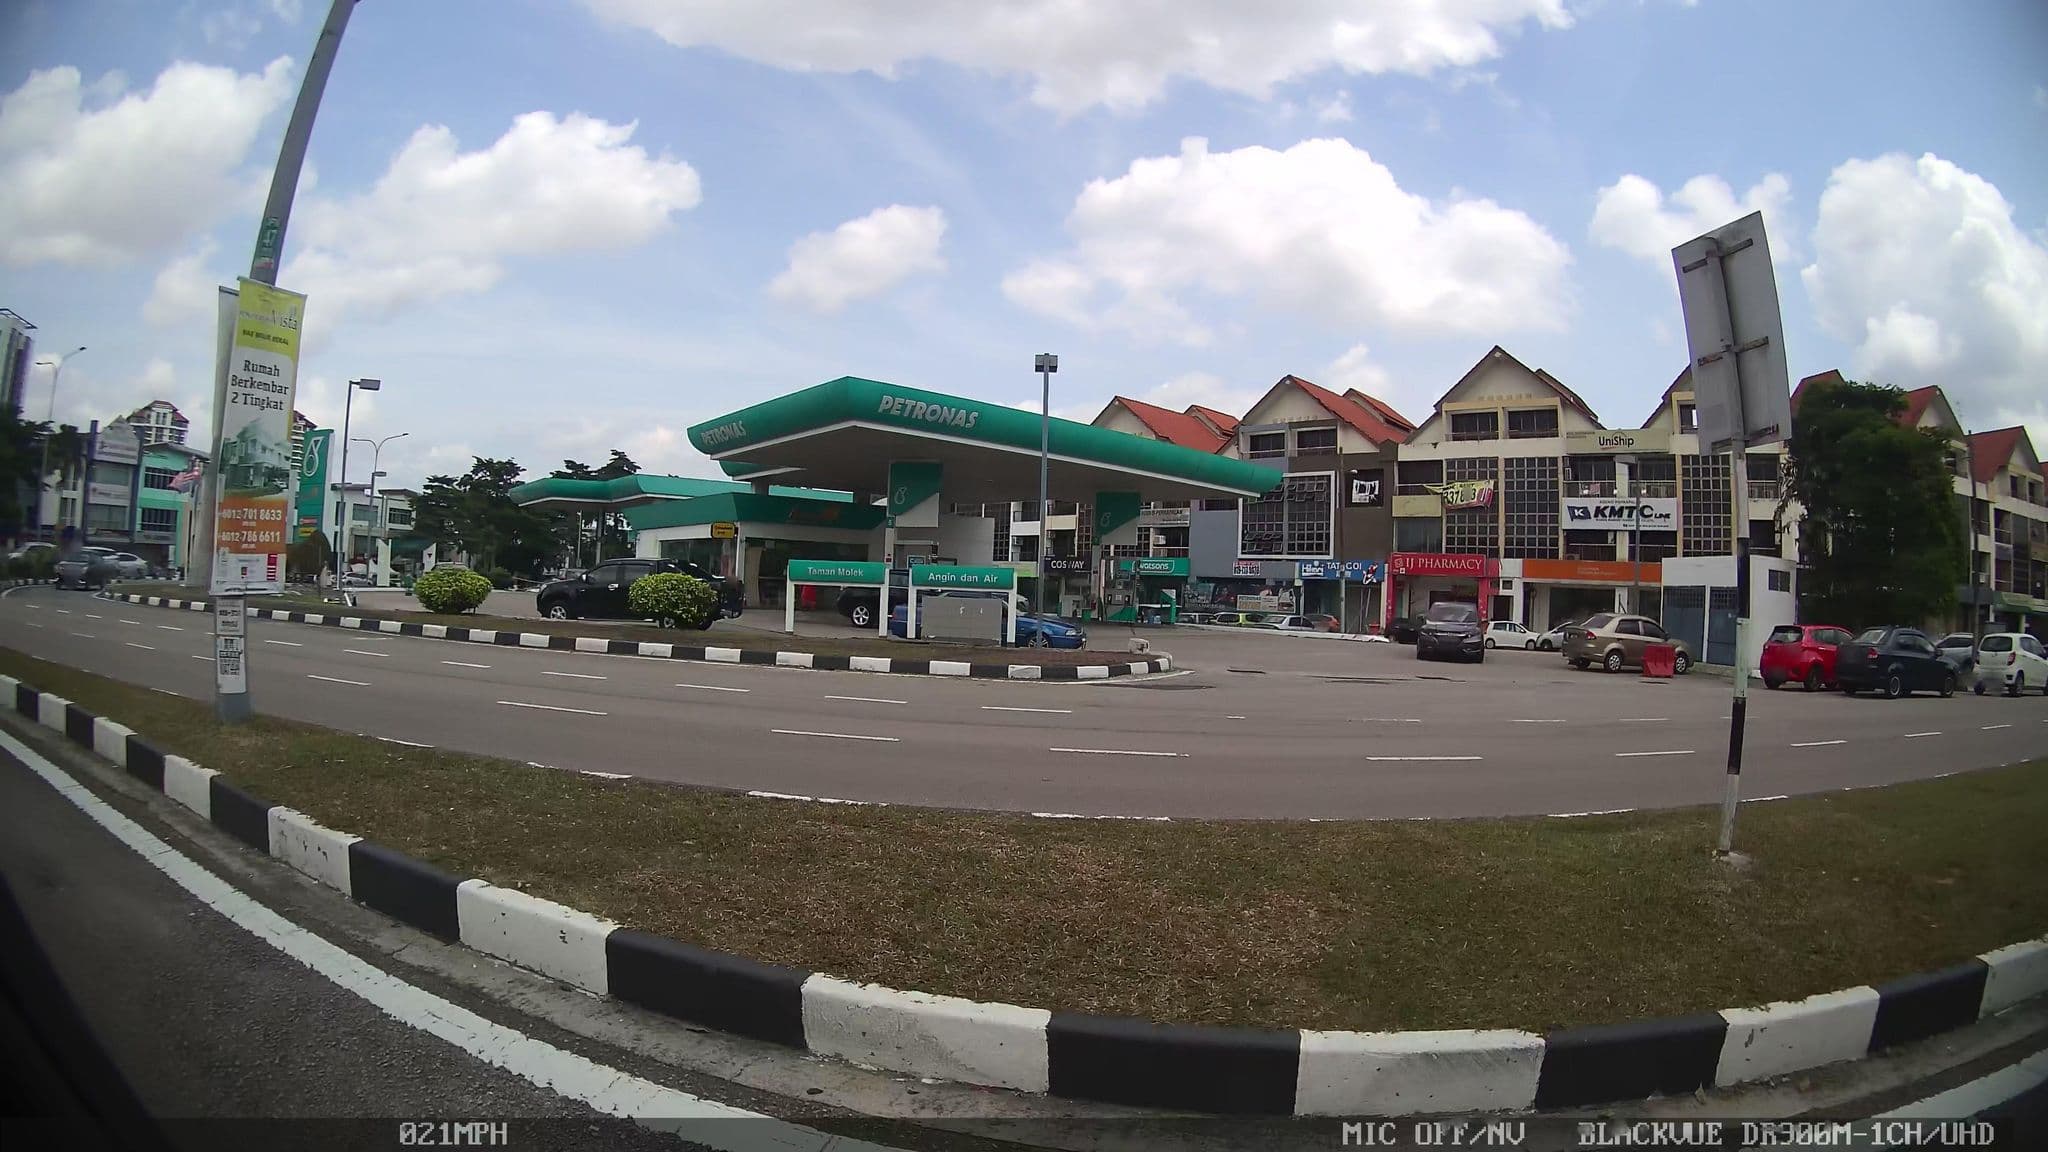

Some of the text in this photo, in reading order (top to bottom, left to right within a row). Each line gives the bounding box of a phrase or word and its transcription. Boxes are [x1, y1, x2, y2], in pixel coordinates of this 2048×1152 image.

[243, 360, 280, 377] Rumah
[231, 375, 289, 395] Berkembar
[231, 391, 284, 411] 2 Tingkat
[878, 395, 978, 428] PETRONAS
[701, 420, 746, 446] PETRONAS
[1598, 436, 1634, 448] UniShip
[1593, 505, 1654, 519] KMTC
[258, 531, 281, 543] 6611
[1406, 557, 1482, 570] IJ PHARMACY
[807, 566, 864, 577] Taman Molek
[928, 572, 998, 583] Angin dan Air
